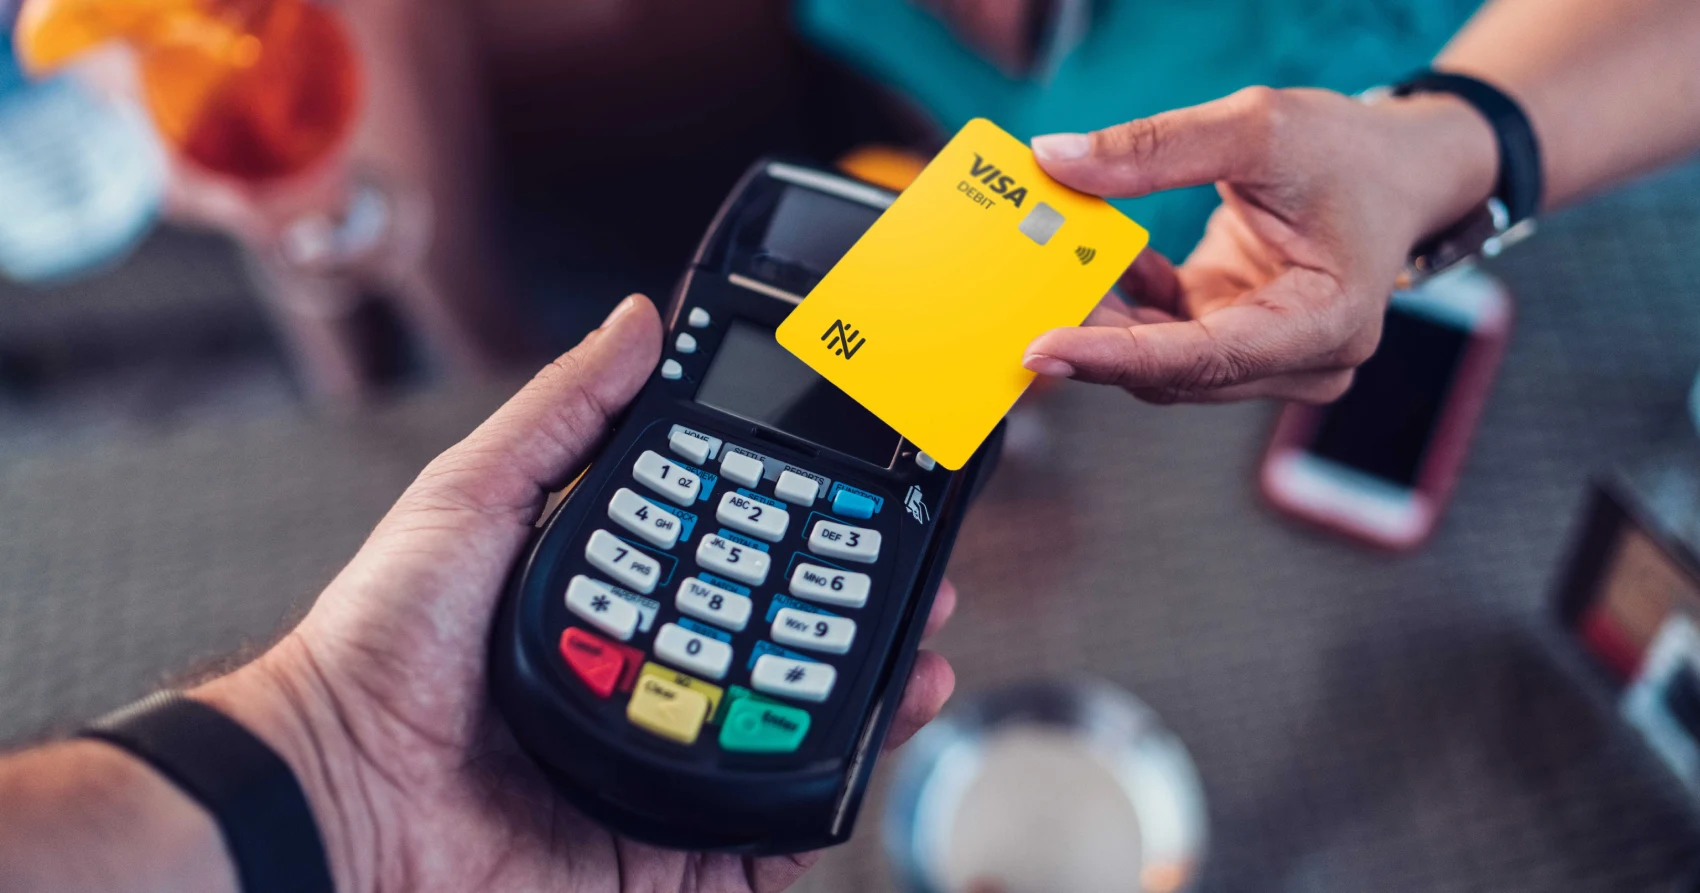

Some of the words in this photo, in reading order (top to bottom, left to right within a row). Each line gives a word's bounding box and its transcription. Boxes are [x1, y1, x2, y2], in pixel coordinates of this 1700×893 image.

[969, 152, 1028, 208] VISA
[956, 180, 996, 210] DEBIT
[660, 465, 671, 479] 1
[678, 478, 693, 488] QZ
[635, 506, 648, 521] 4
[655, 518, 674, 530] GHI
[671, 508, 695, 522] LOCK
[728, 496, 751, 510] ABC
[747, 506, 763, 522] 2
[821, 529, 842, 542] DEF
[845, 531, 861, 547] 3
[612, 547, 629, 563] 7
[630, 562, 652, 576] PRS
[710, 538, 727, 549] JKL
[726, 547, 742, 563] 5
[803, 571, 828, 587] MNO
[830, 576, 845, 592] 6
[688, 583, 711, 598] TUV
[708, 594, 724, 610] 8
[785, 616, 809, 633] WXY
[814, 621, 829, 637] 9
[685, 638, 703, 656] 0
[784, 665, 806, 684] #
